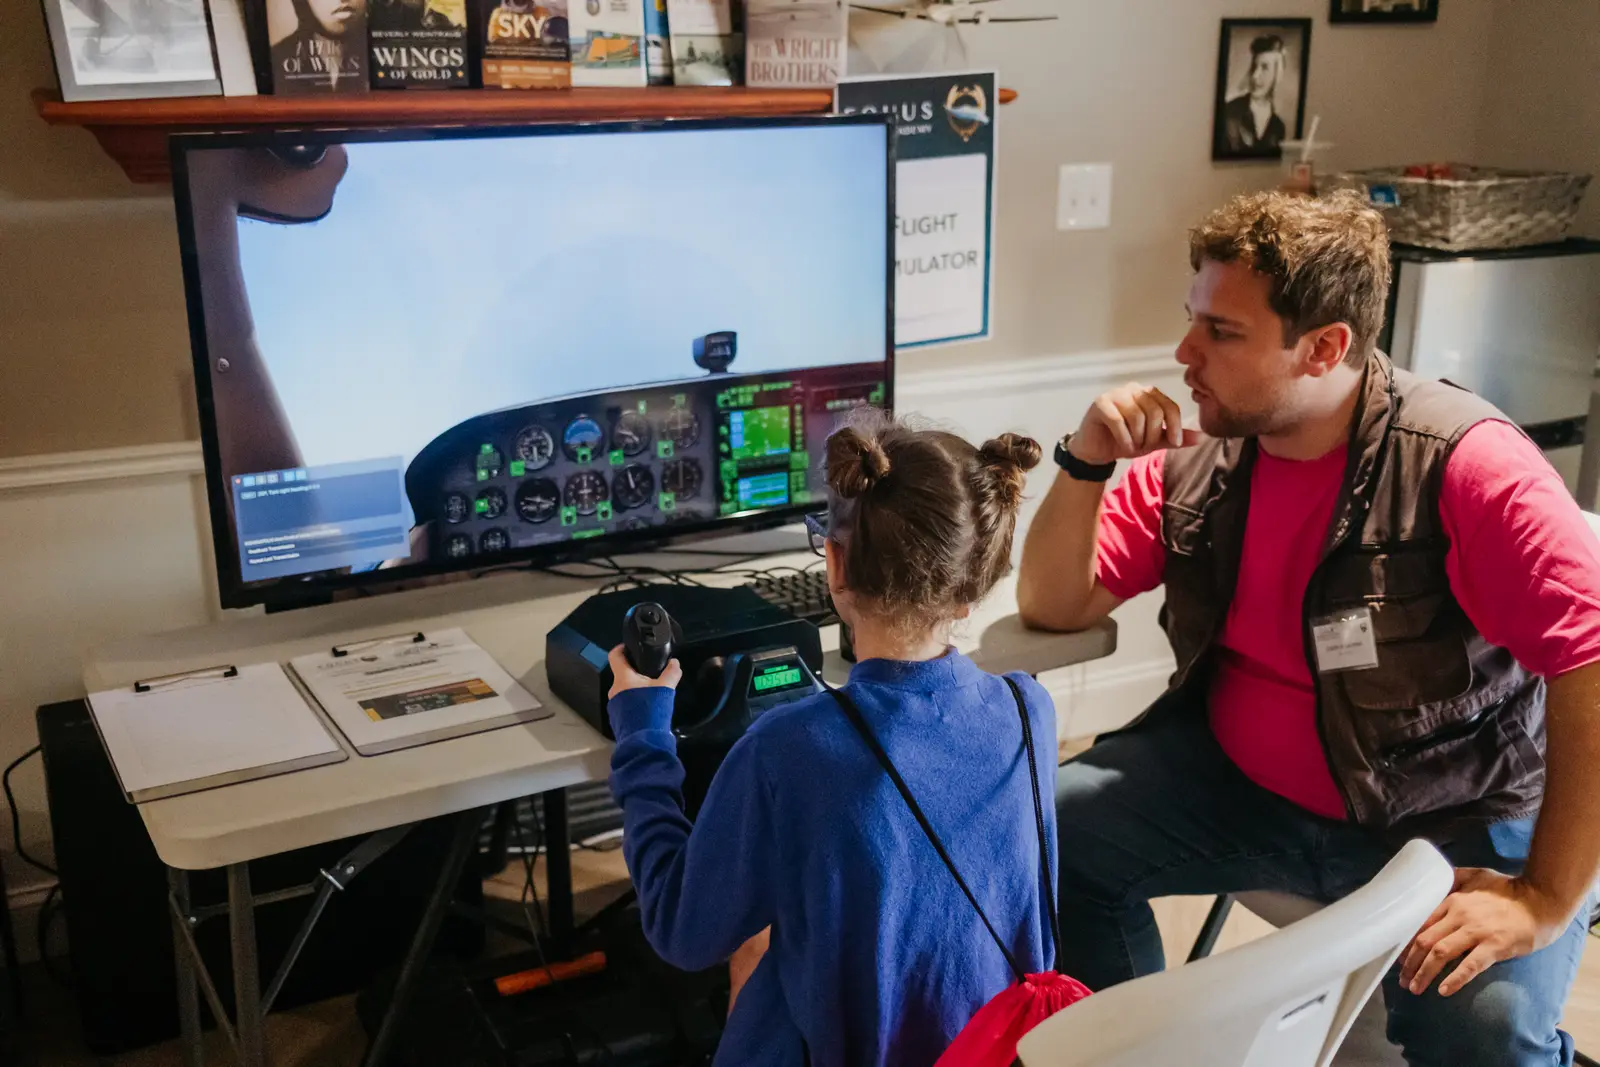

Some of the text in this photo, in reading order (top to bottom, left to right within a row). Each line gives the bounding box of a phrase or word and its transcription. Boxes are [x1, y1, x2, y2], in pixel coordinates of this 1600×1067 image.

[498, 13, 546, 39] SKY
[373, 47, 464, 67] WINGS
[774, 38, 840, 59] WRIGHT
[390, 68, 452, 80] OF GOLD
[750, 61, 838, 83] BROTHERS
